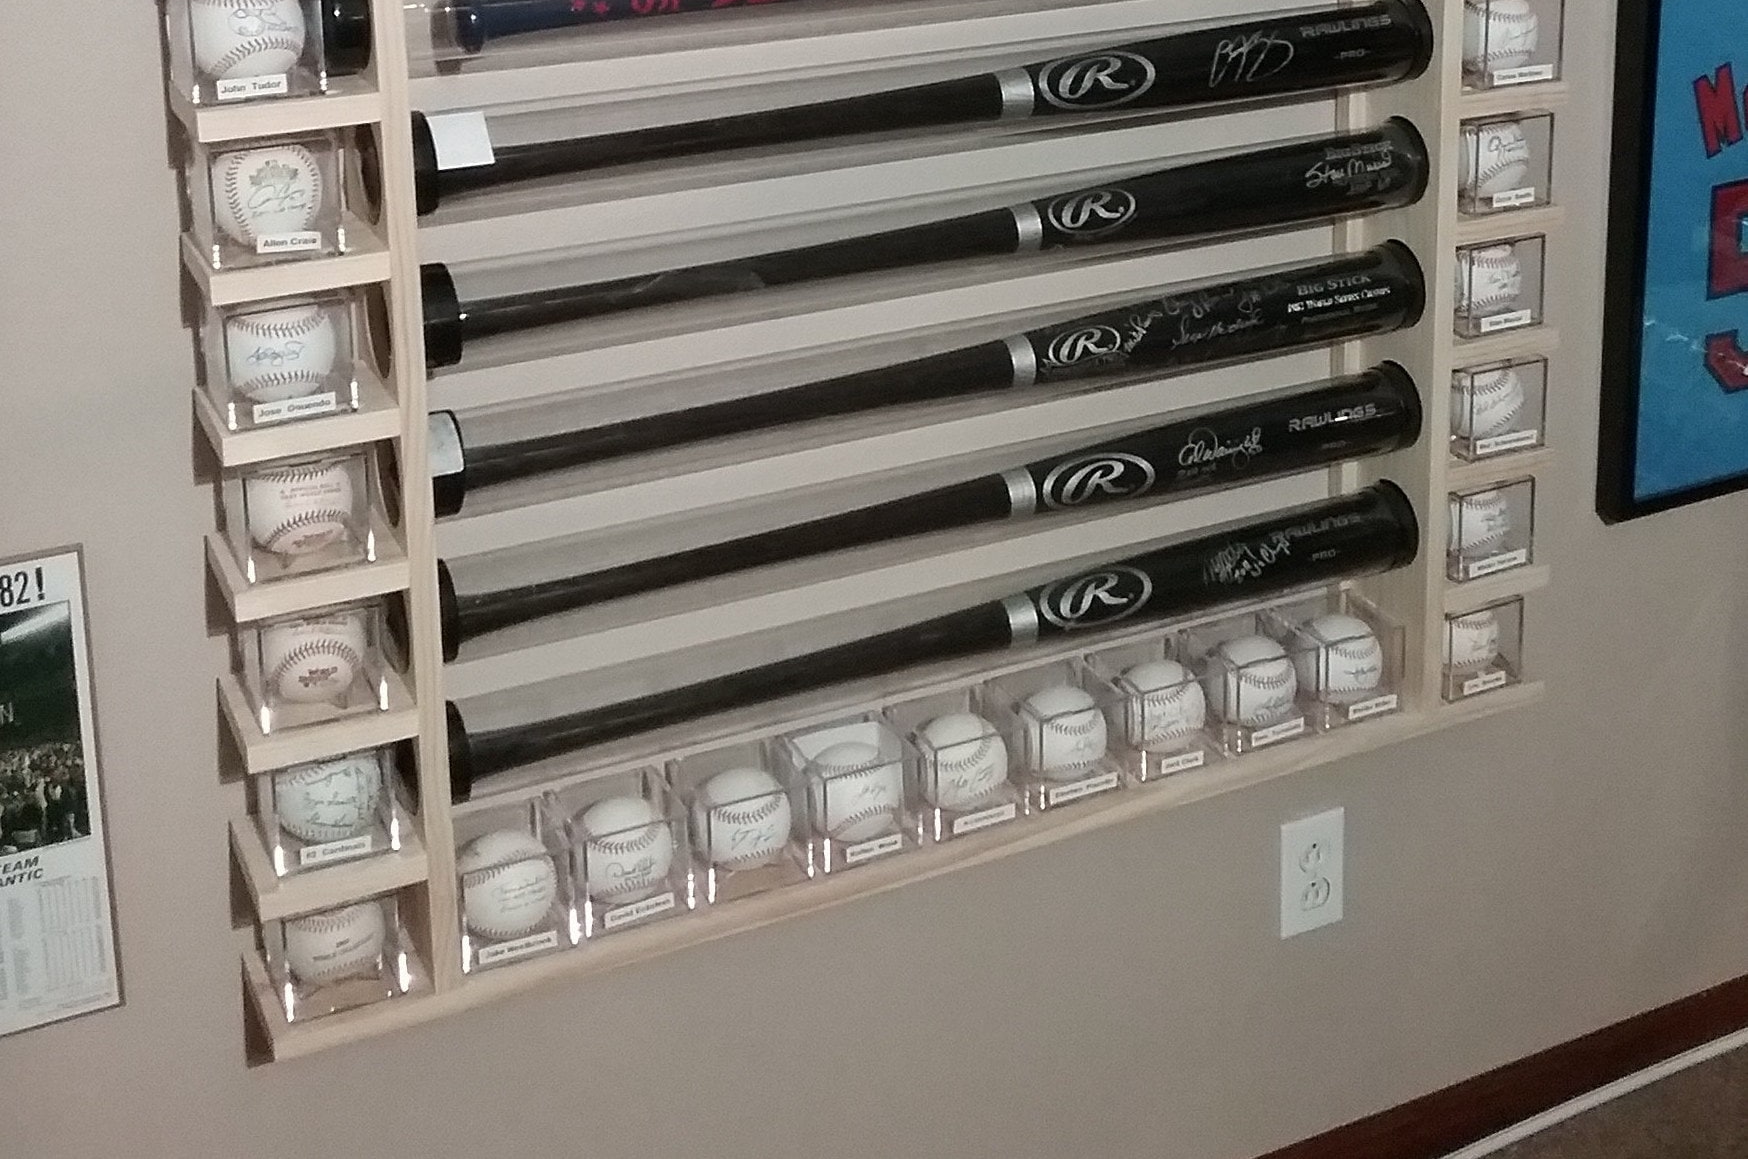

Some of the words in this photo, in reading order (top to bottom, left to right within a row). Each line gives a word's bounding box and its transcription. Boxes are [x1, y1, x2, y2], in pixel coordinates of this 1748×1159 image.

[1299, 14, 1392, 38] RAWLINGS
[221, 85, 246, 94] John
[252, 81, 281, 90] Tudor
[263, 239, 288, 247] Allen
[1296, 283, 1324, 297] BIG
[1326, 275, 1371, 291] STICK
[1288, 403, 1376, 432] RAWLINGS
[0, 855, 39, 874] EAM
